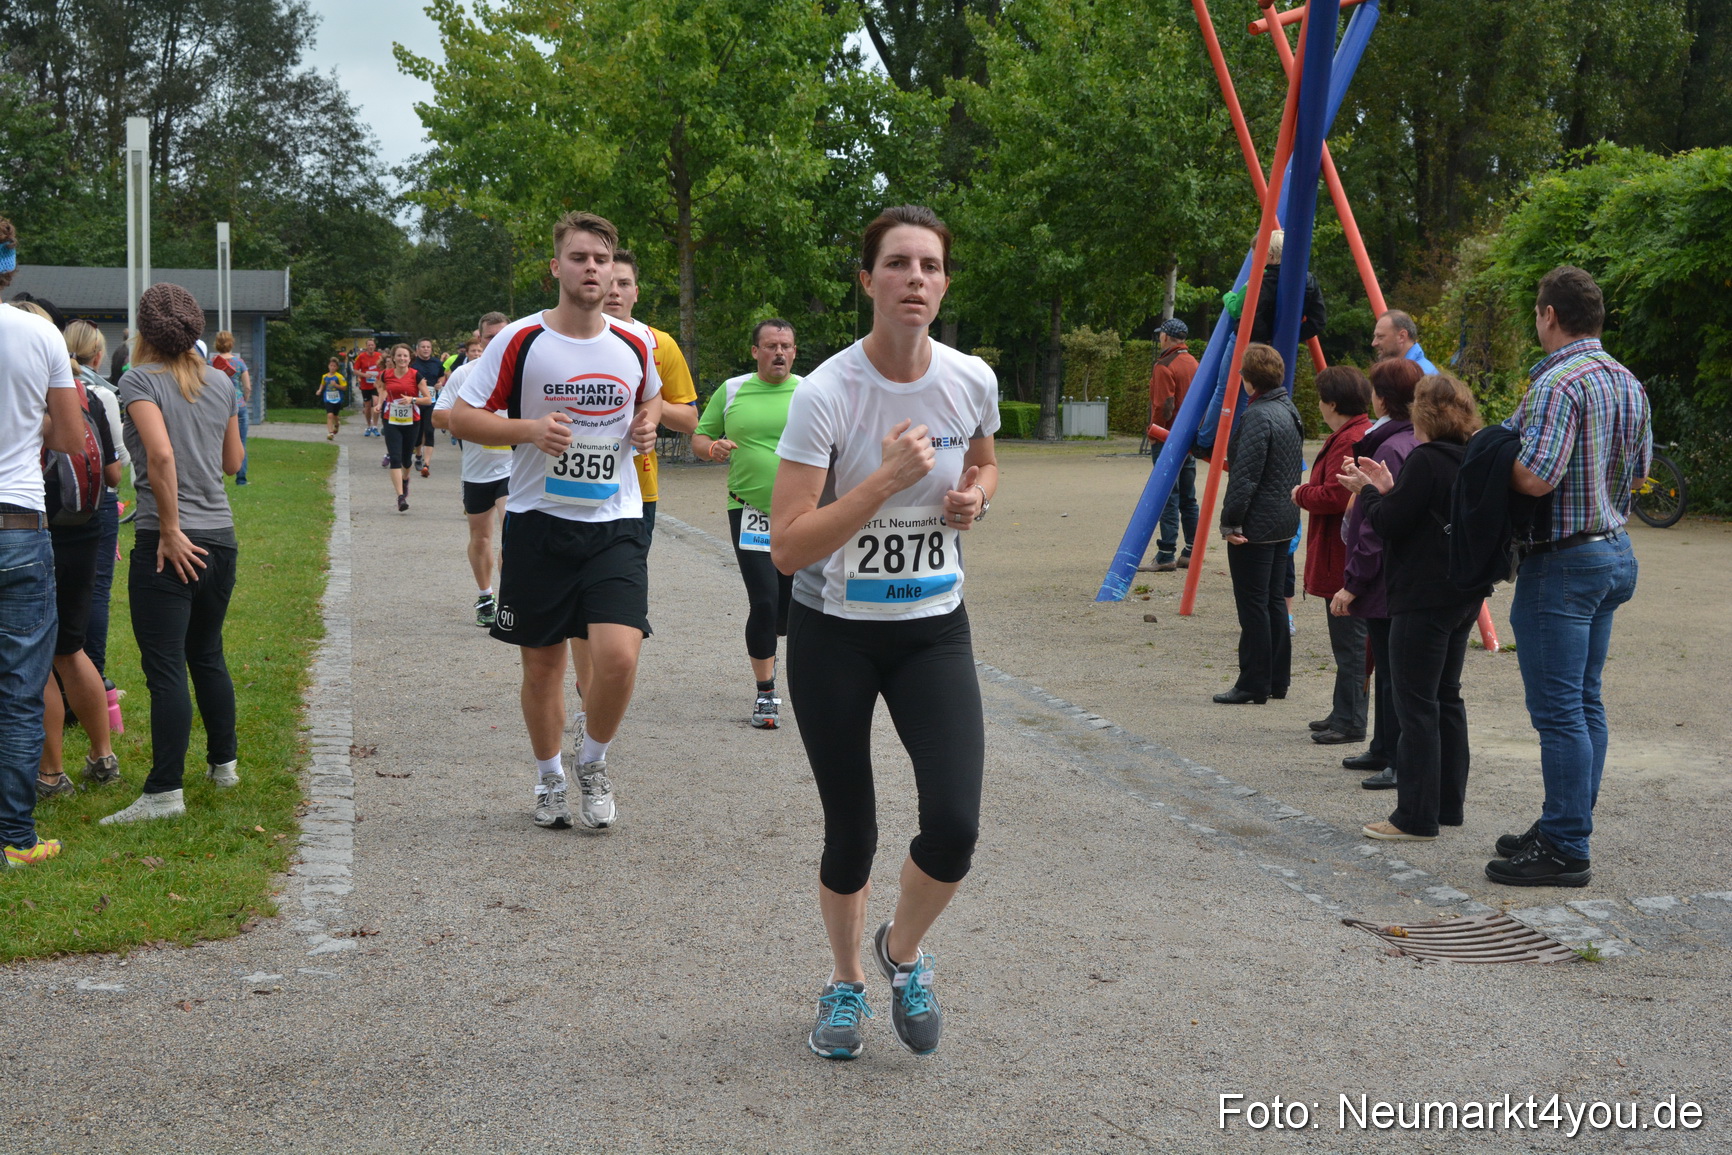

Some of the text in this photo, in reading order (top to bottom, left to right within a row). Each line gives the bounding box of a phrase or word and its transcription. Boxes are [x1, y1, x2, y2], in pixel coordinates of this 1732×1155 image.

[543, 384, 616, 395] GERHART
[576, 394, 624, 406] JÄNIG
[394, 408, 409, 417] 182
[599, 413, 626, 427] Autohaus
[576, 442, 611, 451] Neumarkt
[553, 451, 615, 480] 3359
[889, 516, 937, 528] Neumarkt
[857, 531, 945, 574] 2878
[885, 583, 922, 599] Anke
[500, 610, 514, 626] 90
